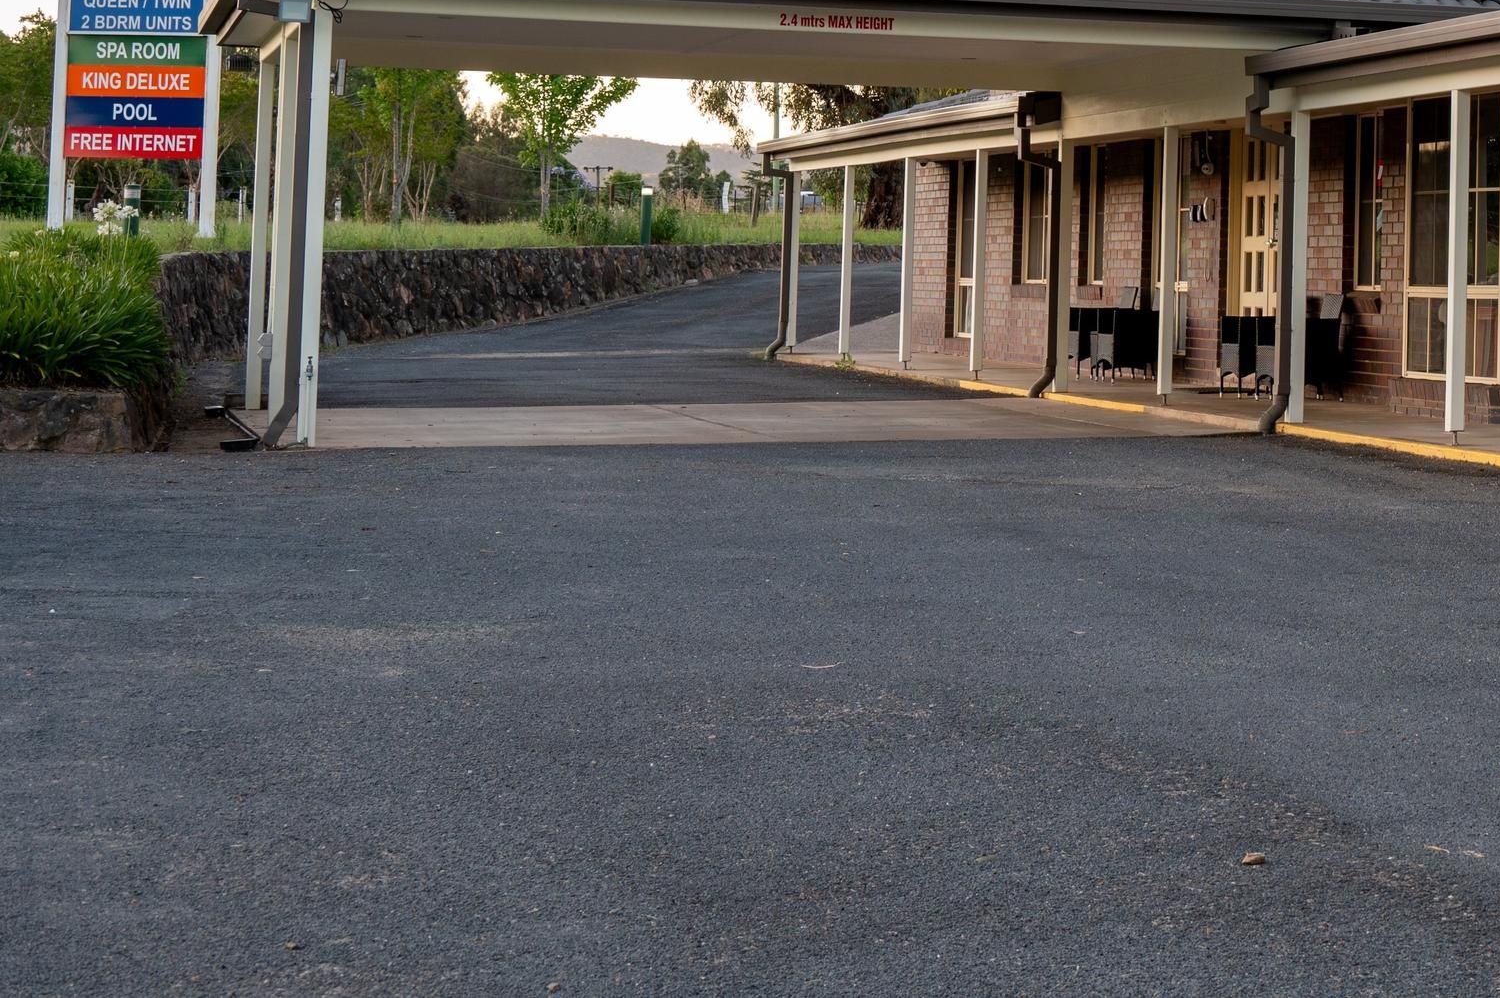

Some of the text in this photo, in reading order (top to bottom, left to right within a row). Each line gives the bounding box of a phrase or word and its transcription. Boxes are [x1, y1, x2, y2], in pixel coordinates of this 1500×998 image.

[81, 15, 192, 30] 2 BDRM UNITS
[780, 13, 895, 31] 2.4 mtrs MAX HEIGHT
[96, 42, 180, 60] SPA ROOM
[82, 72, 190, 91] KING DELUXE
[112, 103, 157, 121] POOL
[70, 133, 197, 152] FREE INTERNET
